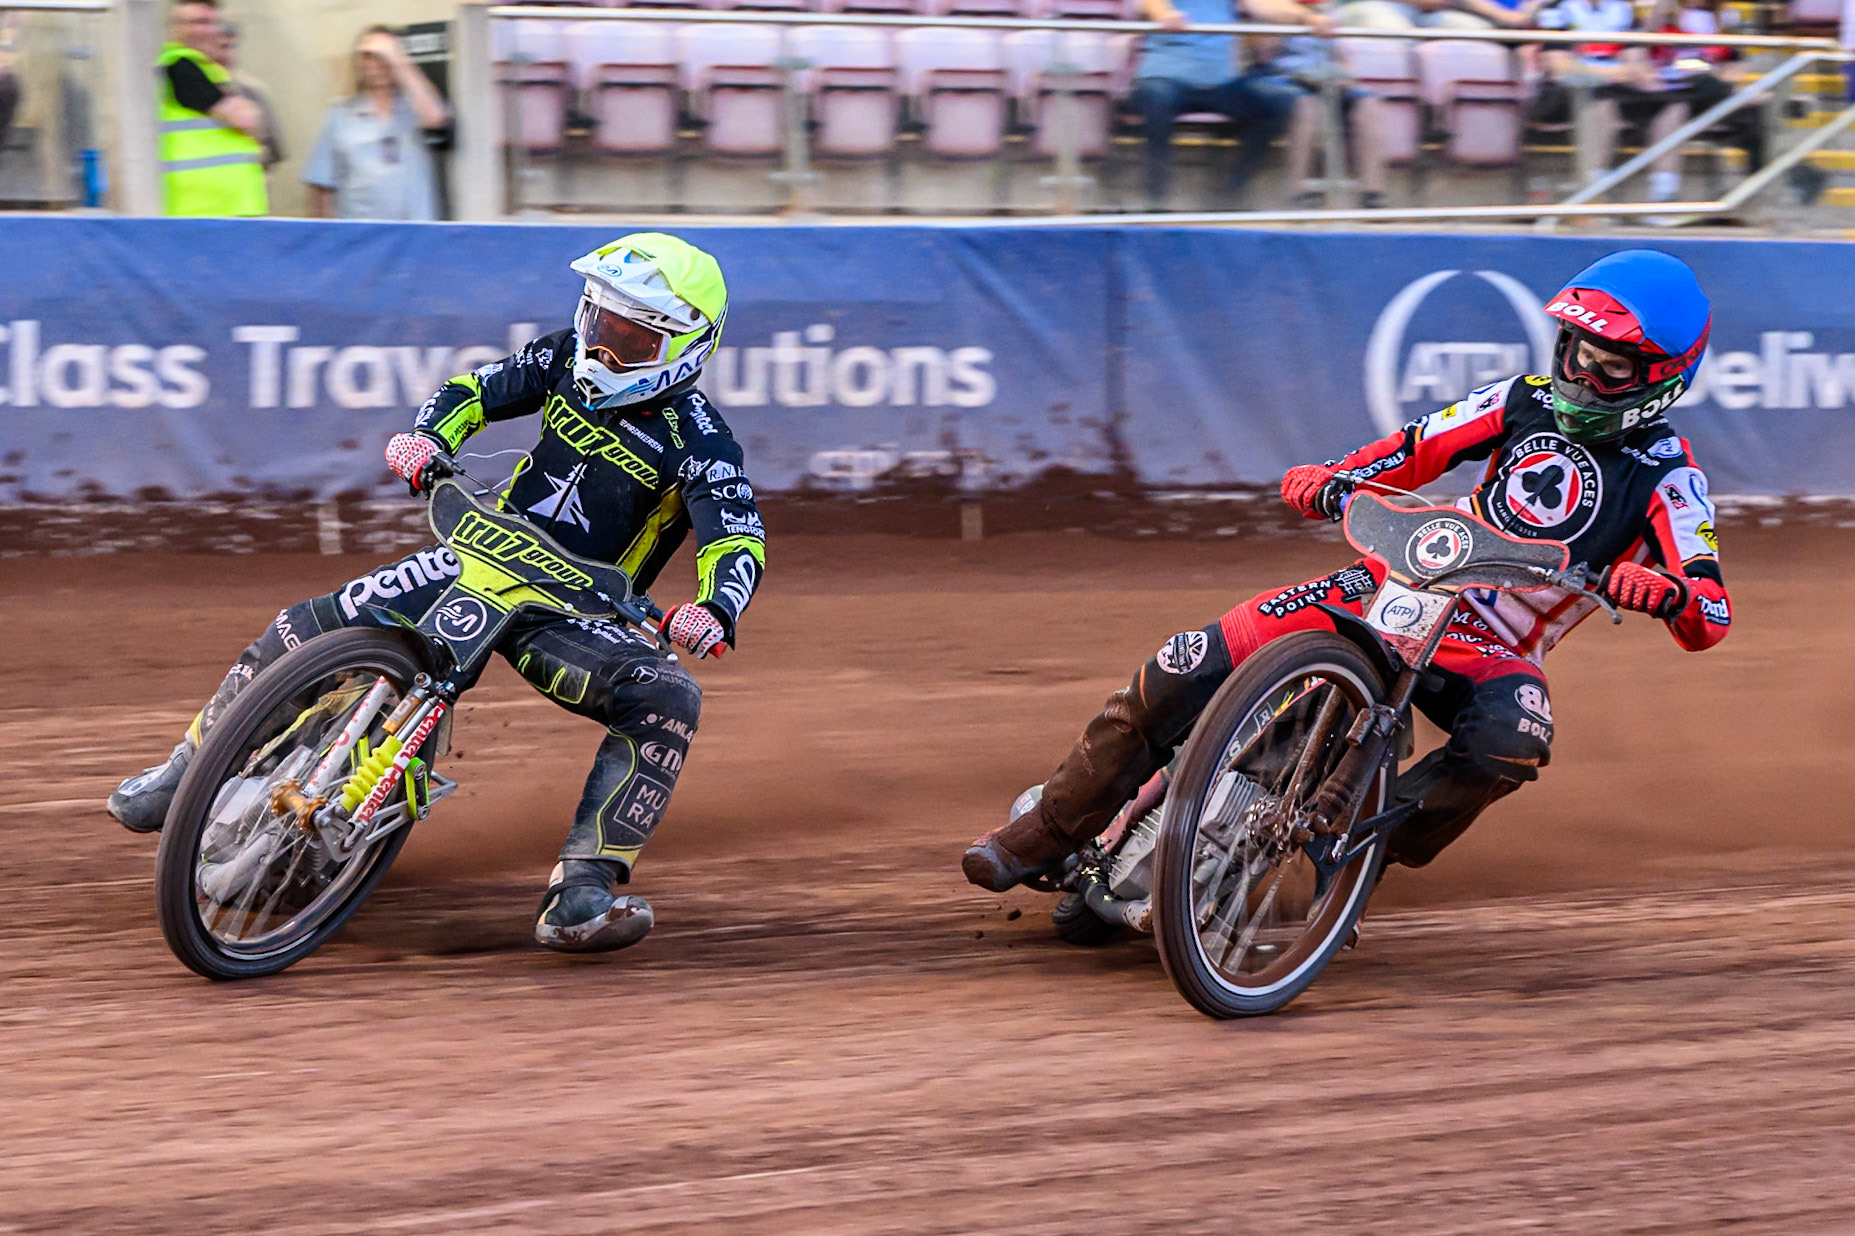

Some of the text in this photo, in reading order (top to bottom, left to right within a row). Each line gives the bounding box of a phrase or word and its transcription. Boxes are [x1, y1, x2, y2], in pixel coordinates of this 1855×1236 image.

[1545, 301, 1608, 333] BOLL
[0, 319, 210, 408] lass
[703, 323, 997, 408] utions
[1621, 381, 1686, 430] BOLL
[1515, 438, 1597, 508] BELLE VUE ACES
[1417, 522, 1441, 539] BELLE
[1444, 521, 1461, 533] VUE
[1260, 579, 1332, 614] EASTERN
[1275, 589, 1327, 617] POINT
[1387, 604, 1416, 620] ATPI
[636, 784, 667, 811] MU
[626, 804, 655, 829] RA
